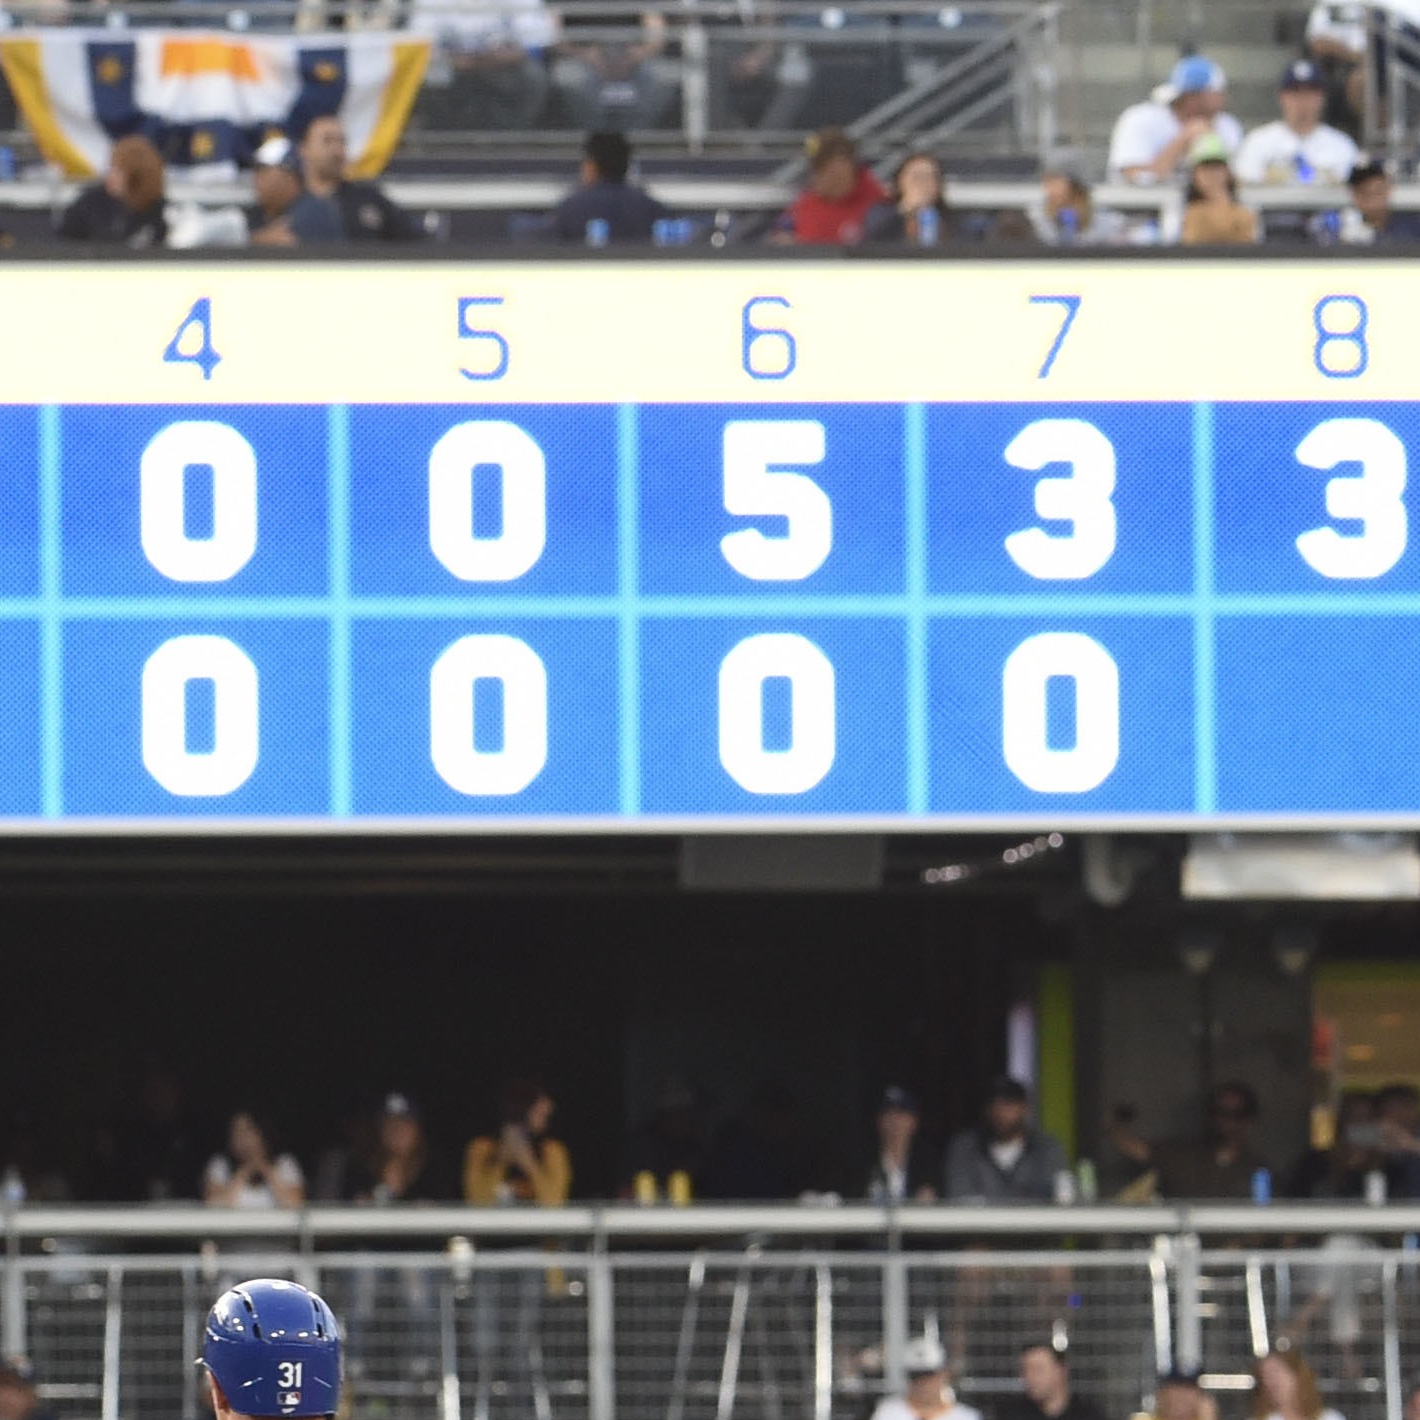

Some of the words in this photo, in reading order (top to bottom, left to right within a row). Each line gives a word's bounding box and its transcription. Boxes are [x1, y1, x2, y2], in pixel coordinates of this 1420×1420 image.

[162, 296, 223, 382] 4
[456, 296, 511, 383] 5
[740, 295, 798, 382] 6
[1027, 294, 1083, 380] 7
[1312, 294, 1370, 381] 8
[140, 421, 258, 583] 0
[428, 420, 546, 582] 0
[720, 420, 833, 581] 5
[1004, 418, 1117, 580] 3
[1295, 418, 1408, 579] 3
[141, 635, 259, 797] 0
[430, 634, 548, 797] 0
[718, 633, 836, 795] 0
[1002, 632, 1120, 794] 0
[277, 1361, 302, 1388] 31
